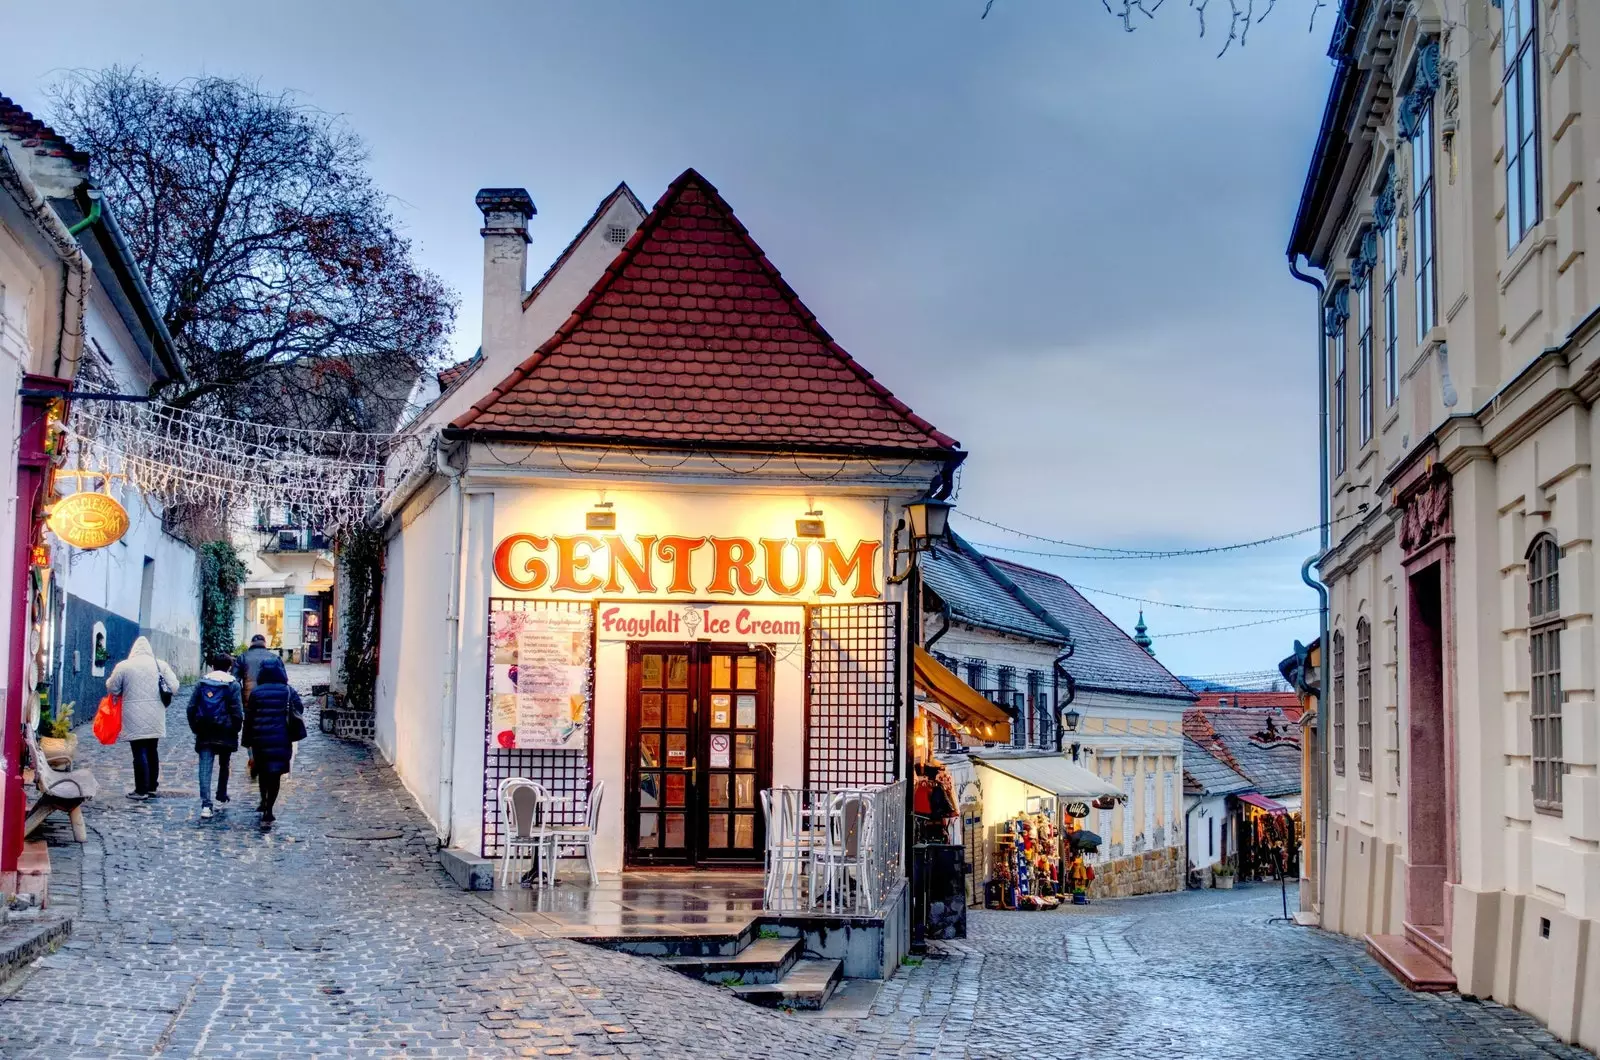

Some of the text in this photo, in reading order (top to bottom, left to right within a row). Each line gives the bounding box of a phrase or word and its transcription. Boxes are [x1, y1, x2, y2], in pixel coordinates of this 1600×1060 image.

[601, 607, 801, 637] Fagylalt Ice Cream
